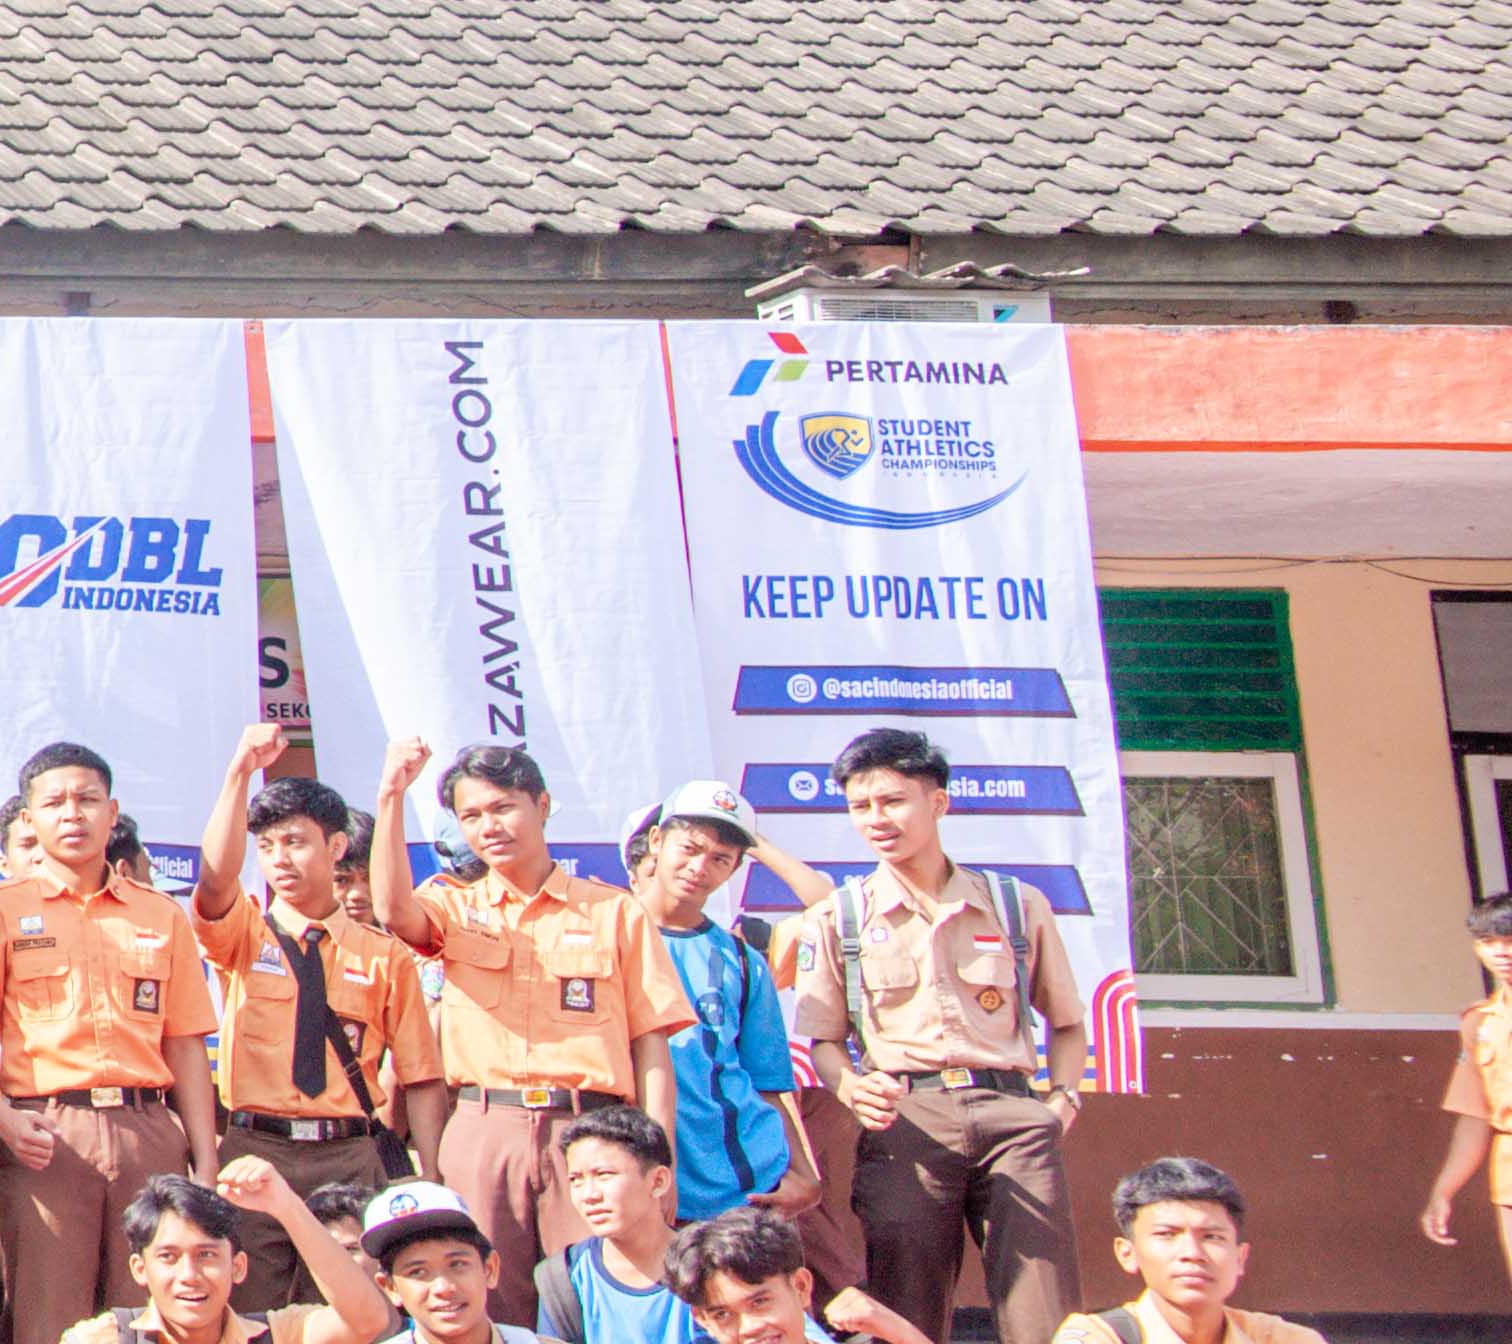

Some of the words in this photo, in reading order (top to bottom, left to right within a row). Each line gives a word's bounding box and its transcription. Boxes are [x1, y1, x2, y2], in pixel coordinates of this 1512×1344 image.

[825, 360, 1009, 385] PERTAMINA
[877, 418, 972, 438] STUDENT
[880, 439, 996, 459] ATHLETICS
[881, 458, 997, 472] CHAMPIONSHIPS
[64, 515, 224, 587] DBL
[443, 340, 528, 752] ZAWEAR.COM
[61, 586, 221, 616] INDONESIA
[742, 574, 835, 619] KEEP
[845, 574, 988, 621] UPDATE
[996, 577, 1049, 622] ON
[822, 676, 1014, 701] @sacindonesiaofficial
